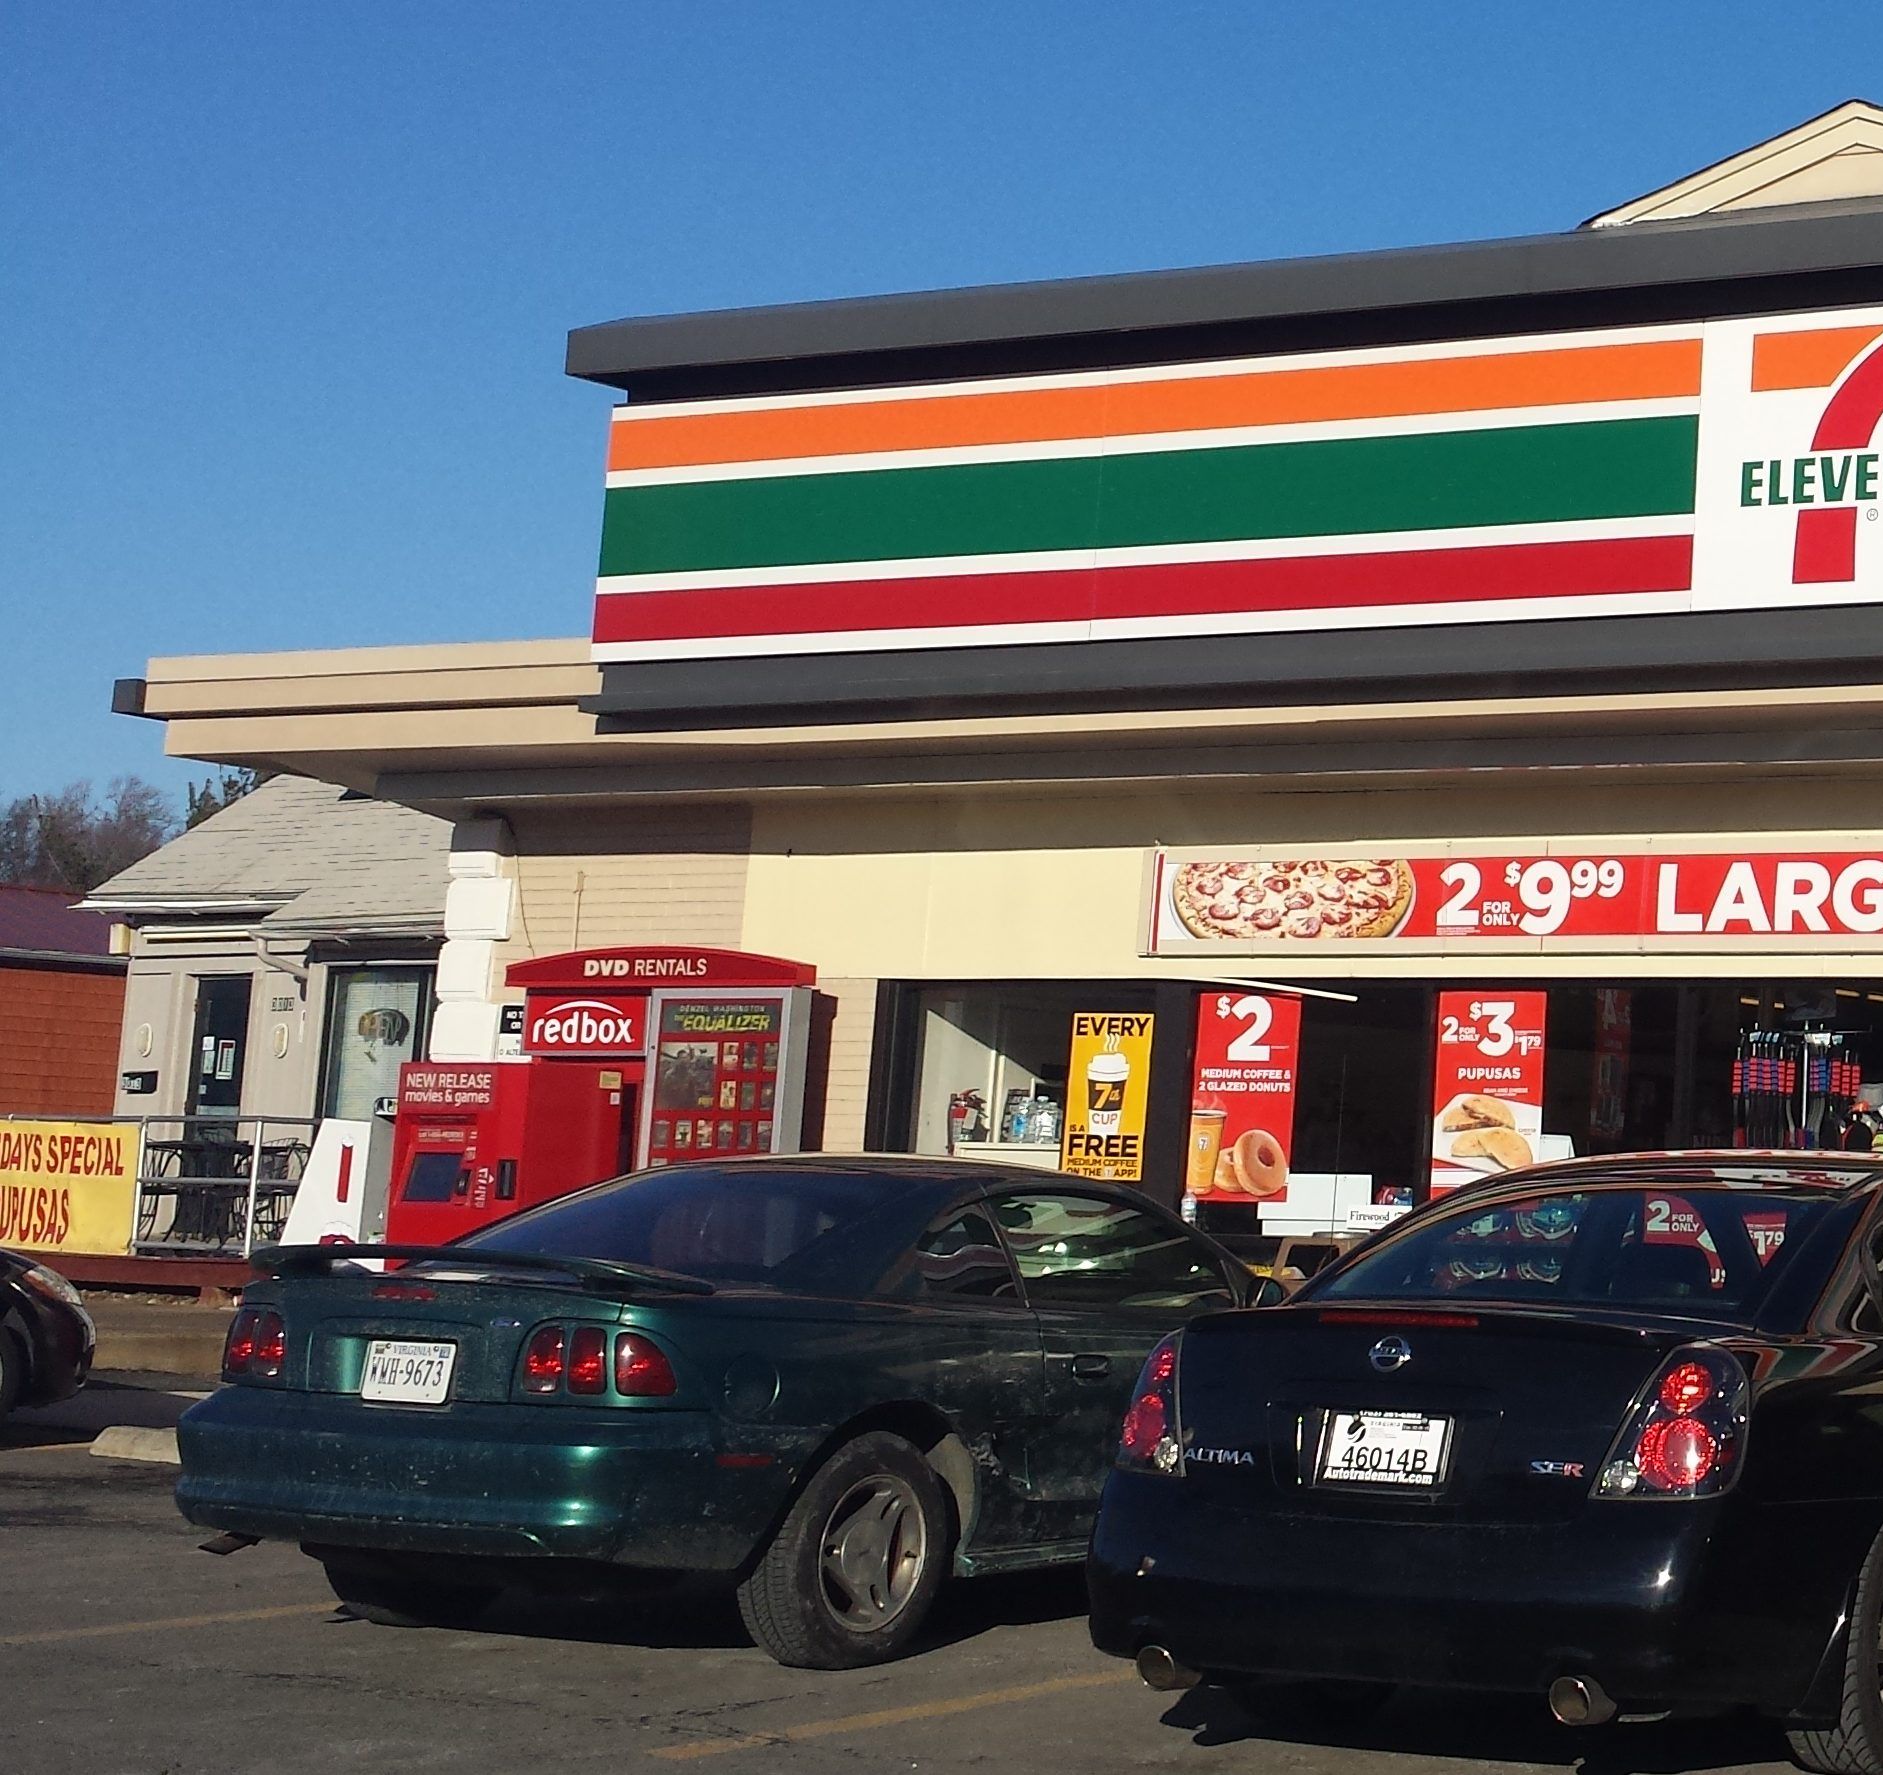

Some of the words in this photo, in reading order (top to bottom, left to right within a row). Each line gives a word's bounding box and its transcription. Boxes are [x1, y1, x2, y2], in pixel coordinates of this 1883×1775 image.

[1435, 861, 1482, 926] 2
[1482, 901, 1511, 914] FOR
[1482, 914, 1520, 926] ONLY
[583, 960, 630, 977] DVD
[634, 958, 707, 976] RENTALS
[532, 1011, 633, 1046] redbox
[683, 1015, 770, 1031] EQUALIZER
[1076, 1017, 1150, 1036] EVERY
[1216, 995, 1273, 1061] $2
[1441, 1015, 1459, 1042] 2
[1469, 1001, 1515, 1056] $3
[1459, 1034, 1480, 1042] ONLY
[406, 1073, 435, 1088] NEW
[438, 1073, 492, 1089] RELEASE
[1201, 1068, 1241, 1080] MEDIUM
[1243, 1069, 1282, 1080] COFFEE
[1284, 1070, 1291, 1080] &
[1458, 1067, 1522, 1080] PUPUSAS
[1199, 1081, 1206, 1091] 2
[1207, 1081, 1247, 1092] GLAZED
[1249, 1082, 1291, 1093] DONUTS
[405, 1090, 443, 1102] movies
[445, 1089, 453, 1102] &
[454, 1092, 490, 1107] games
[1092, 1113, 1118, 1125] CUP
[1069, 1124, 1076, 1132] IS
[1079, 1124, 1085, 1132] A
[1067, 1134, 1139, 1157] FREE
[0, 1133, 42, 1172] DAYS
[46, 1135, 124, 1176] SPECIAL
[1067, 1158, 1101, 1166] MEDIUM
[1103, 1159, 1138, 1167] COFFEE
[1083, 1168, 1102, 1176] THE
[0, 1186, 69, 1244] UPUSAS
[1350, 1210, 1390, 1222] Firewood
[1647, 1200, 1671, 1232] 2
[1671, 1214, 1694, 1223] FOR
[1671, 1223, 1700, 1232] ONLY
[393, 1345, 432, 1356] VIRGINIA
[1184, 1447, 1255, 1465] ALTIMA
[1341, 1446, 1428, 1472] 46014B
[1323, 1467, 1433, 1485] Autotrademark.com
